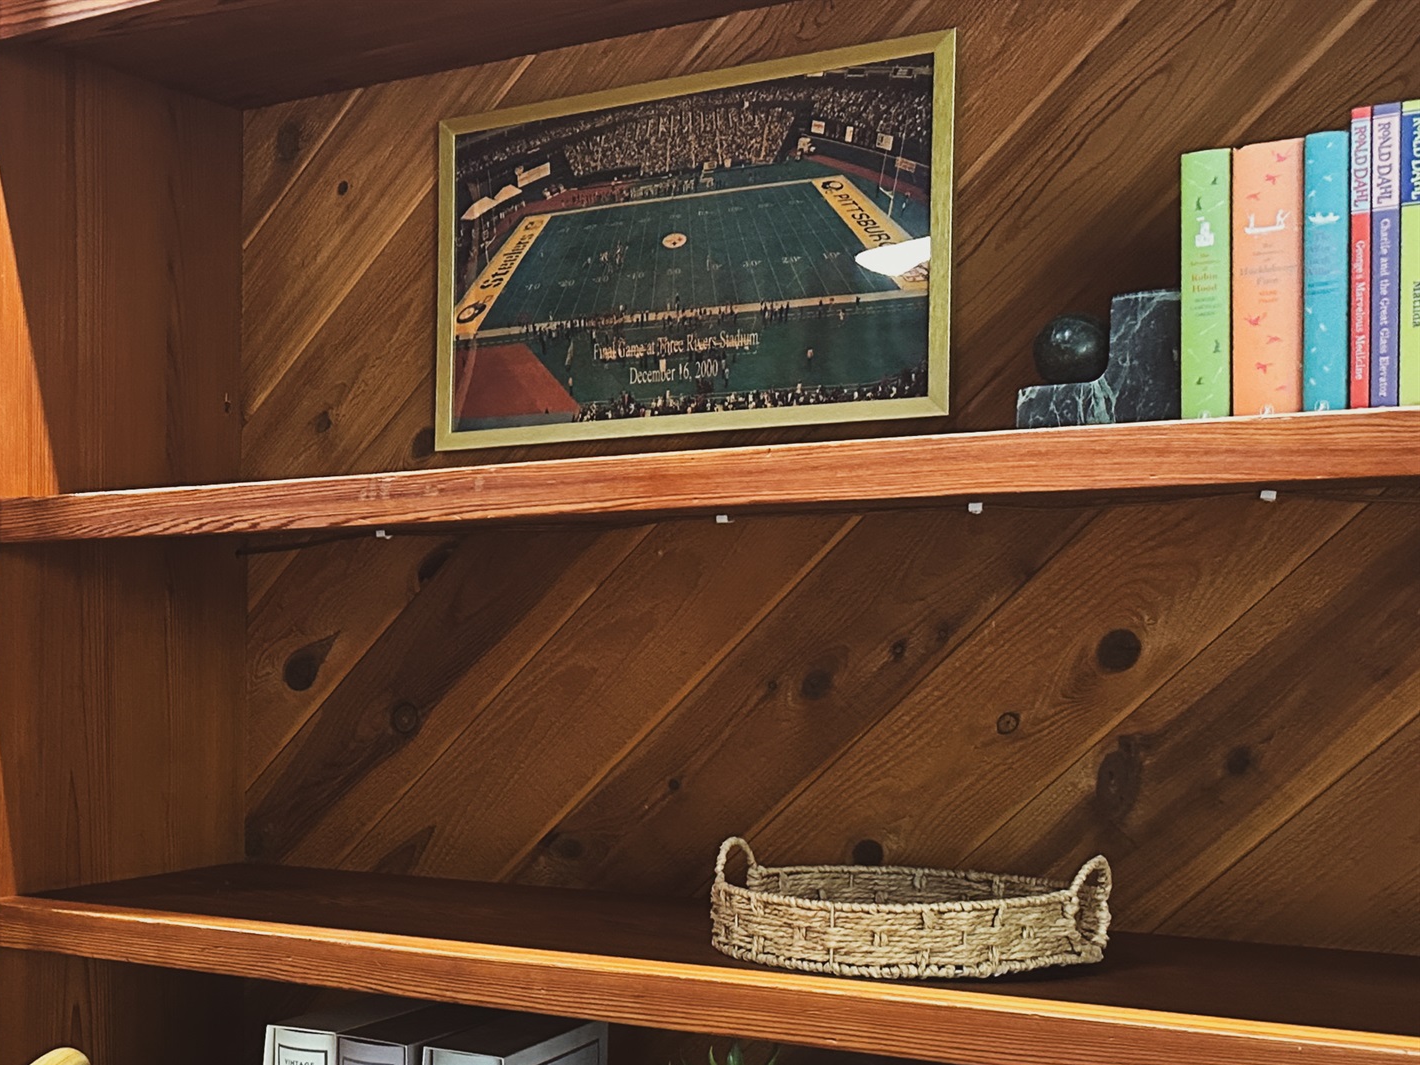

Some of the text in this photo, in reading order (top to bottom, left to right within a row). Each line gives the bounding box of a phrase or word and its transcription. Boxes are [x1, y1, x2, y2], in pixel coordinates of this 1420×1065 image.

[1353, 125, 1368, 208] ROALD DAHL
[1376, 120, 1393, 205] ROALD DAHL
[1380, 257, 1391, 276] and
[1379, 278, 1391, 296] the
[1379, 297, 1390, 326] Great
[593, 338, 617, 360] Final
[618, 339, 647, 358] Game
[657, 336, 684, 357] Three
[687, 332, 717, 353] Rivers
[720, 329, 759, 349] Stadium
[630, 366, 676, 385] December
[695, 358, 719, 379] 2000
